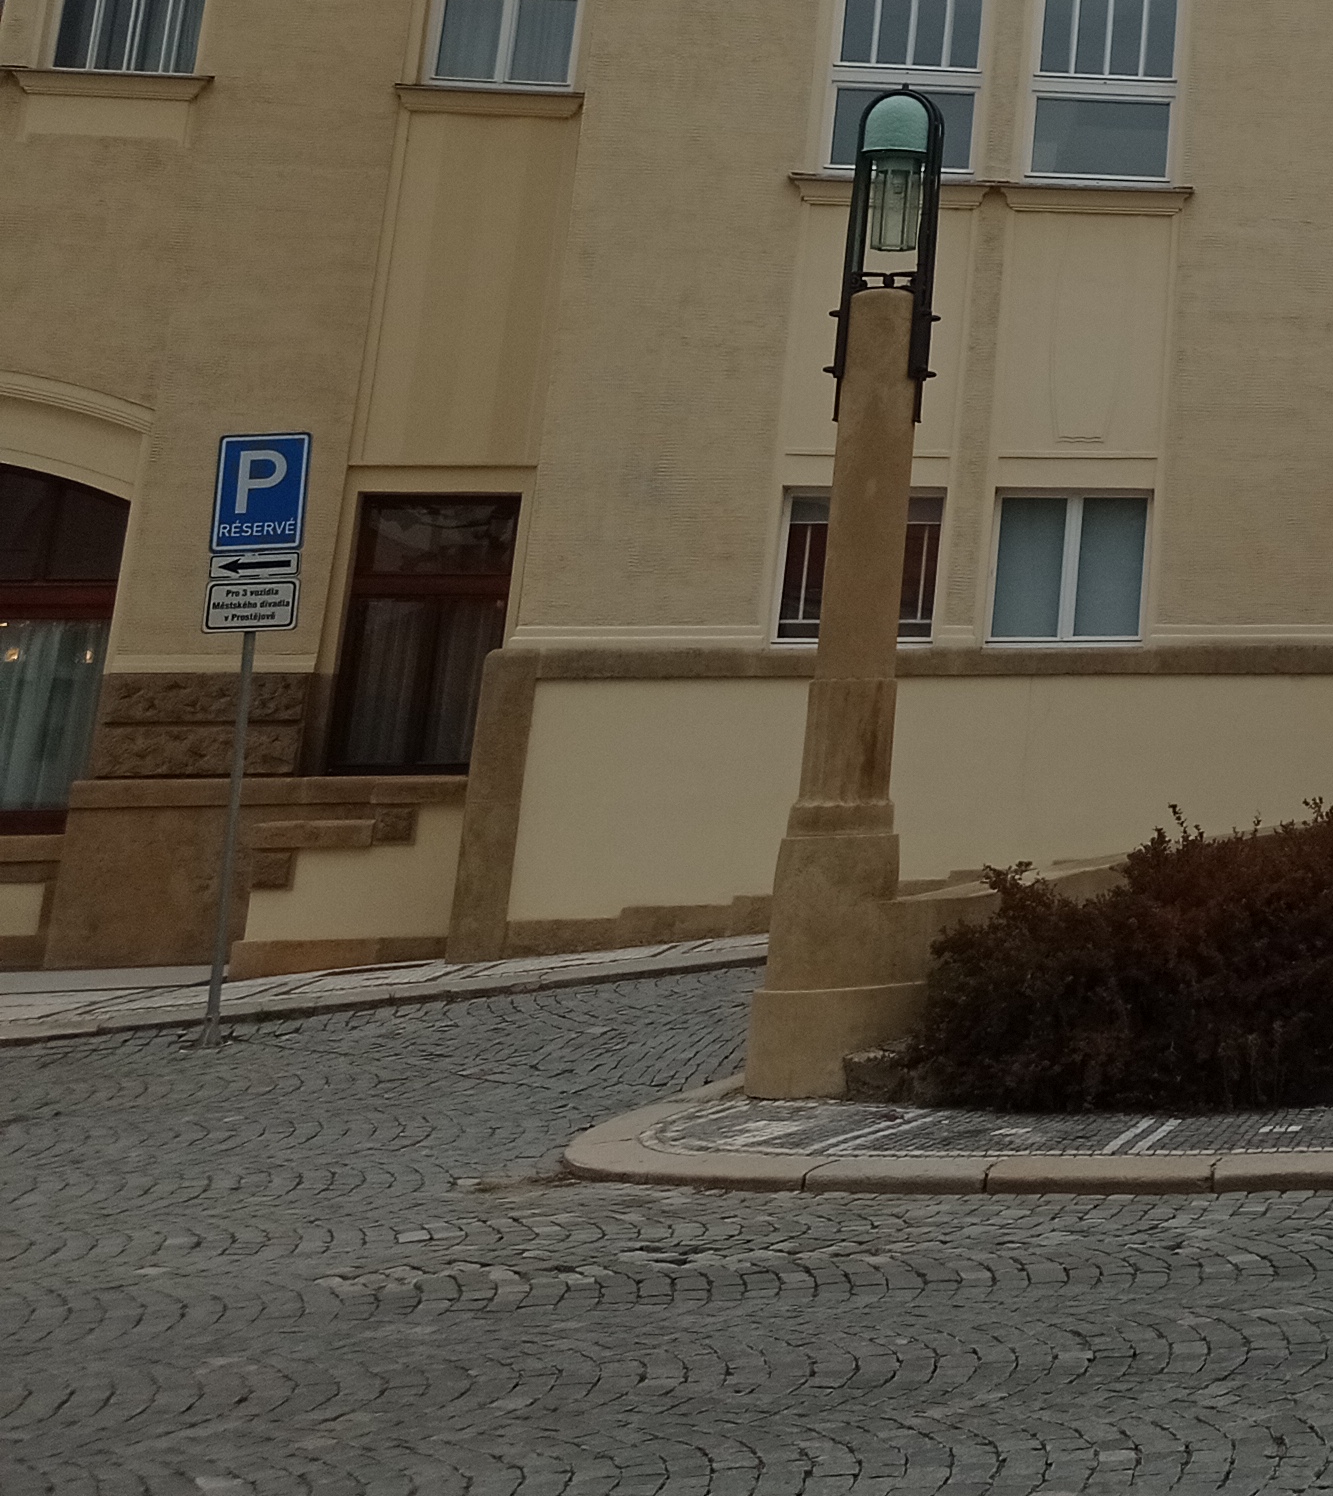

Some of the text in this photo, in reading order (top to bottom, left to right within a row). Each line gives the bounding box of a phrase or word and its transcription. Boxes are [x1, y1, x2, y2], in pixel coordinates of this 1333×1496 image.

[234, 449, 288, 514] P
[219, 518, 295, 537] RÉSERVÉ
[225, 588, 279, 597] Pro 3 vozidla
[212, 599, 290, 610] Městského divadla
[224, 612, 276, 622] v Prostějově
